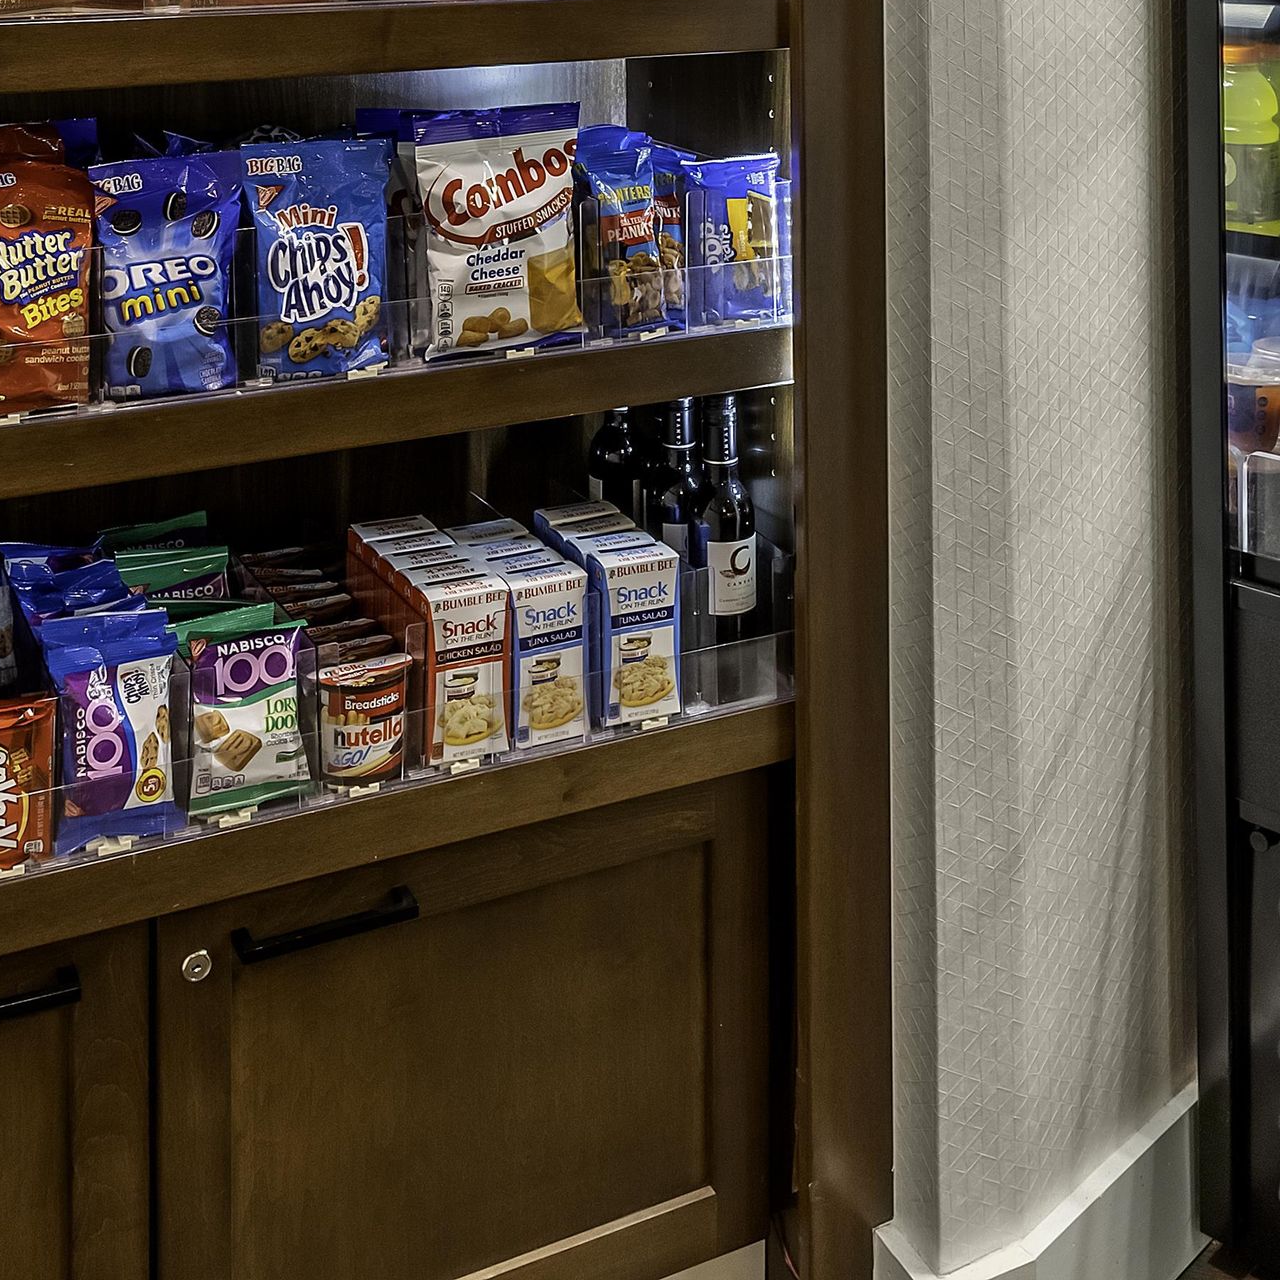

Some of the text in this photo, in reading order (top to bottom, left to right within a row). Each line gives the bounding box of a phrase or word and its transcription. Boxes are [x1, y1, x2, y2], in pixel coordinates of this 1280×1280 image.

[246, 155, 302, 176] BIG BAG
[275, 202, 337, 230] Mini
[494, 193, 568, 239] STUFFED SNACKS
[466, 247, 526, 267] Cheddar
[0, 248, 84, 303] Butter
[470, 264, 521, 281] Cheese
[20, 287, 83, 330] Bites
[121, 279, 201, 321] mini
[616, 558, 676, 579] BUMBLE BEE
[524, 577, 583, 600] BUMBLE BEE
[616, 582, 669, 605] Snack
[442, 590, 504, 612] BUMBLE BEE
[524, 601, 578, 626] Snack
[441, 614, 498, 638] Snack
[216, 634, 287, 657] NABISCO
[527, 629, 577, 647] TUNA SALAD
[437, 642, 502, 663] CHICKEN SALAD
[344, 691, 401, 711] Breadsticks
[76, 707, 87, 778] NABISCO
[333, 718, 403, 748] nutella
